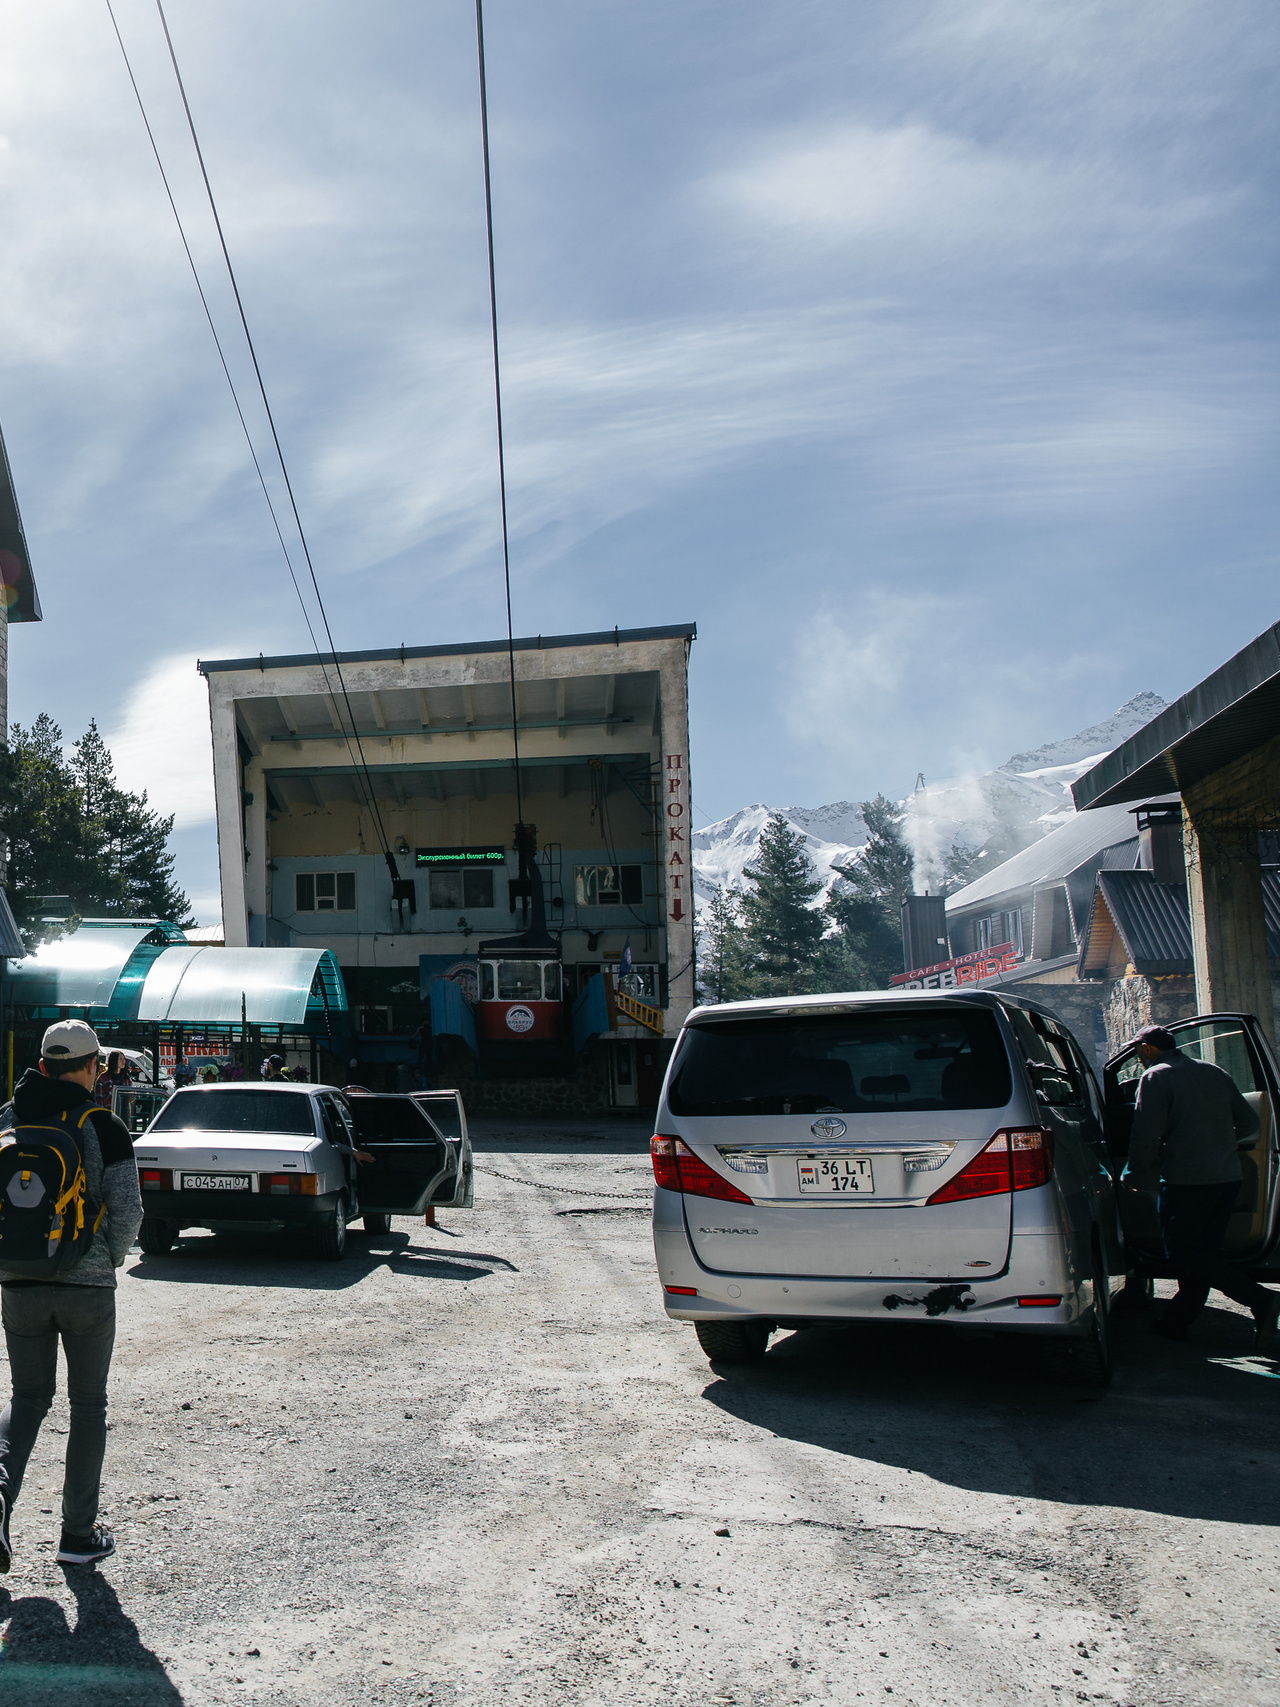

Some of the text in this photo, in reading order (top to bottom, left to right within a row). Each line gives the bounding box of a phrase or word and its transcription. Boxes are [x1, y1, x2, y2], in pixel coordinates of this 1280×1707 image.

[666, 755, 684, 889] ПРОКАТ
[417, 853, 465, 862] Экскурсионный
[909, 949, 994, 979] CAFE HOTEL
[821, 1161, 866, 1175] 36 LT
[801, 1177, 815, 1185] AM
[831, 1177, 858, 1191] 174
